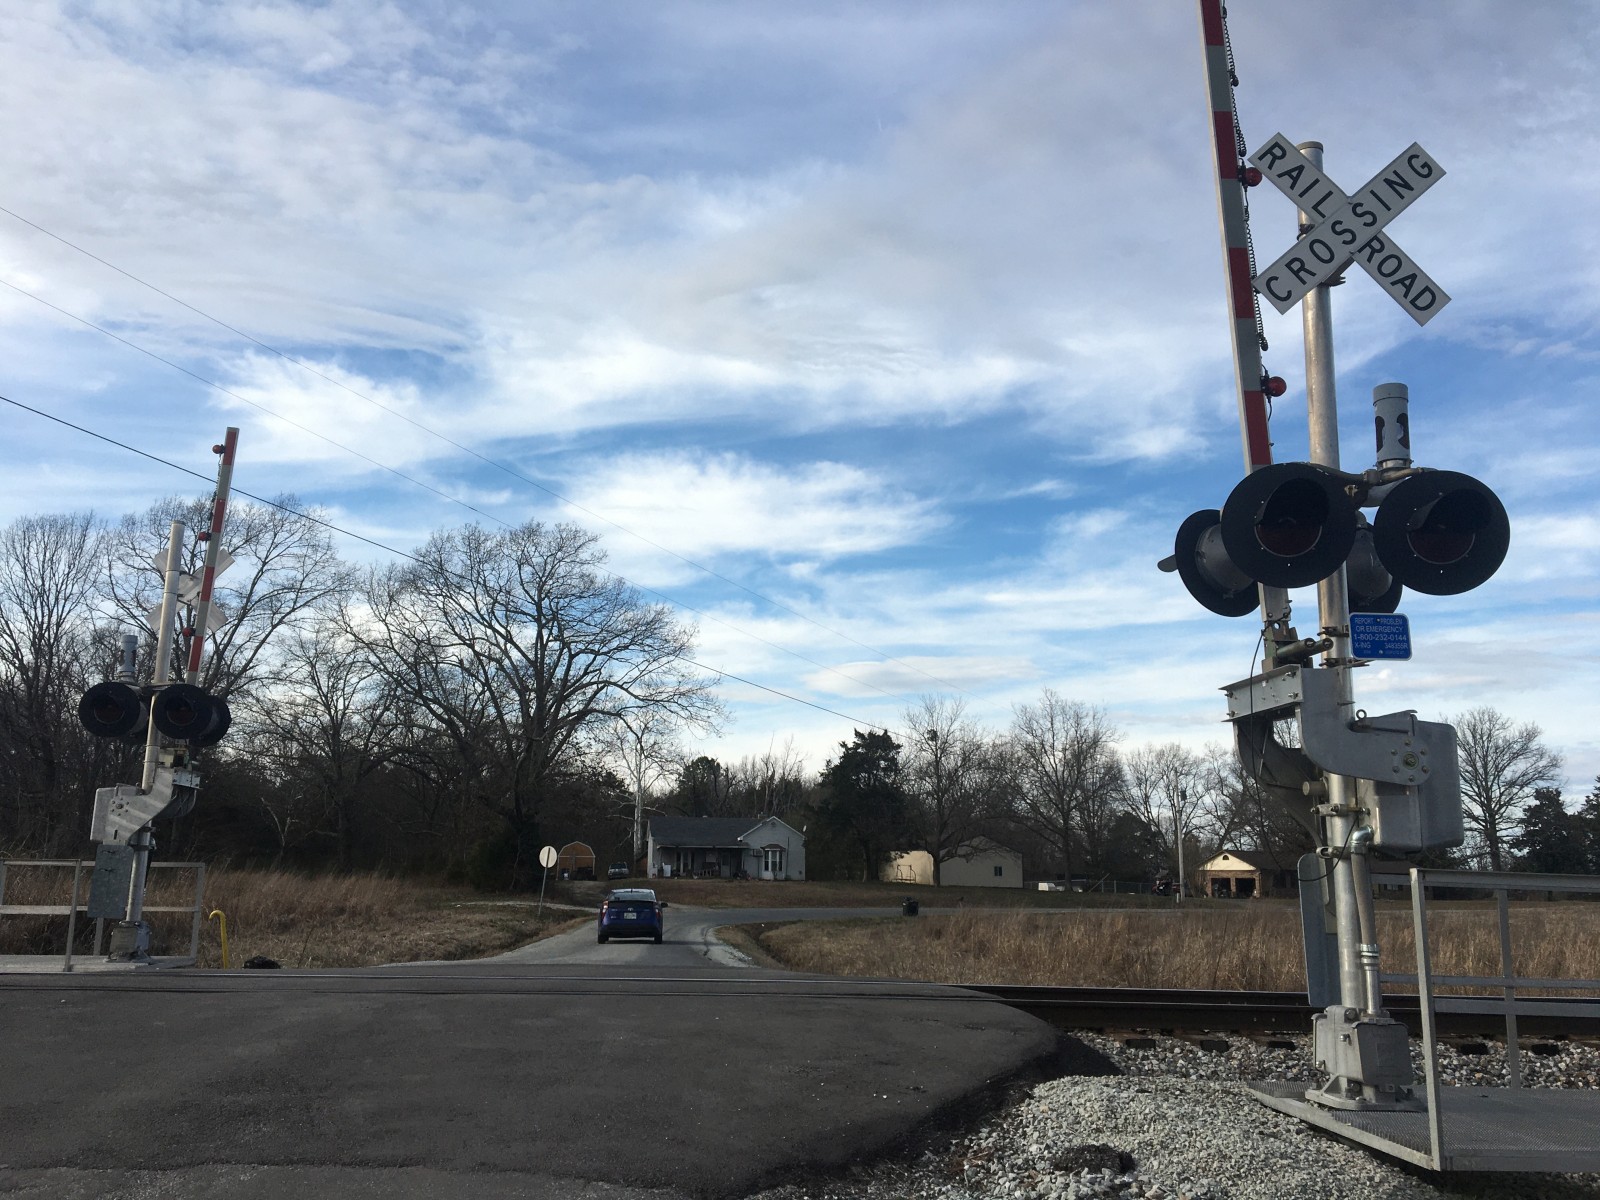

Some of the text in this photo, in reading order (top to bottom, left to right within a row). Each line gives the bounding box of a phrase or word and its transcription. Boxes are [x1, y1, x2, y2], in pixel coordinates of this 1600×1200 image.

[1257, 141, 1437, 312] RAIL ROAD
[1265, 153, 1434, 303] CROSSING
